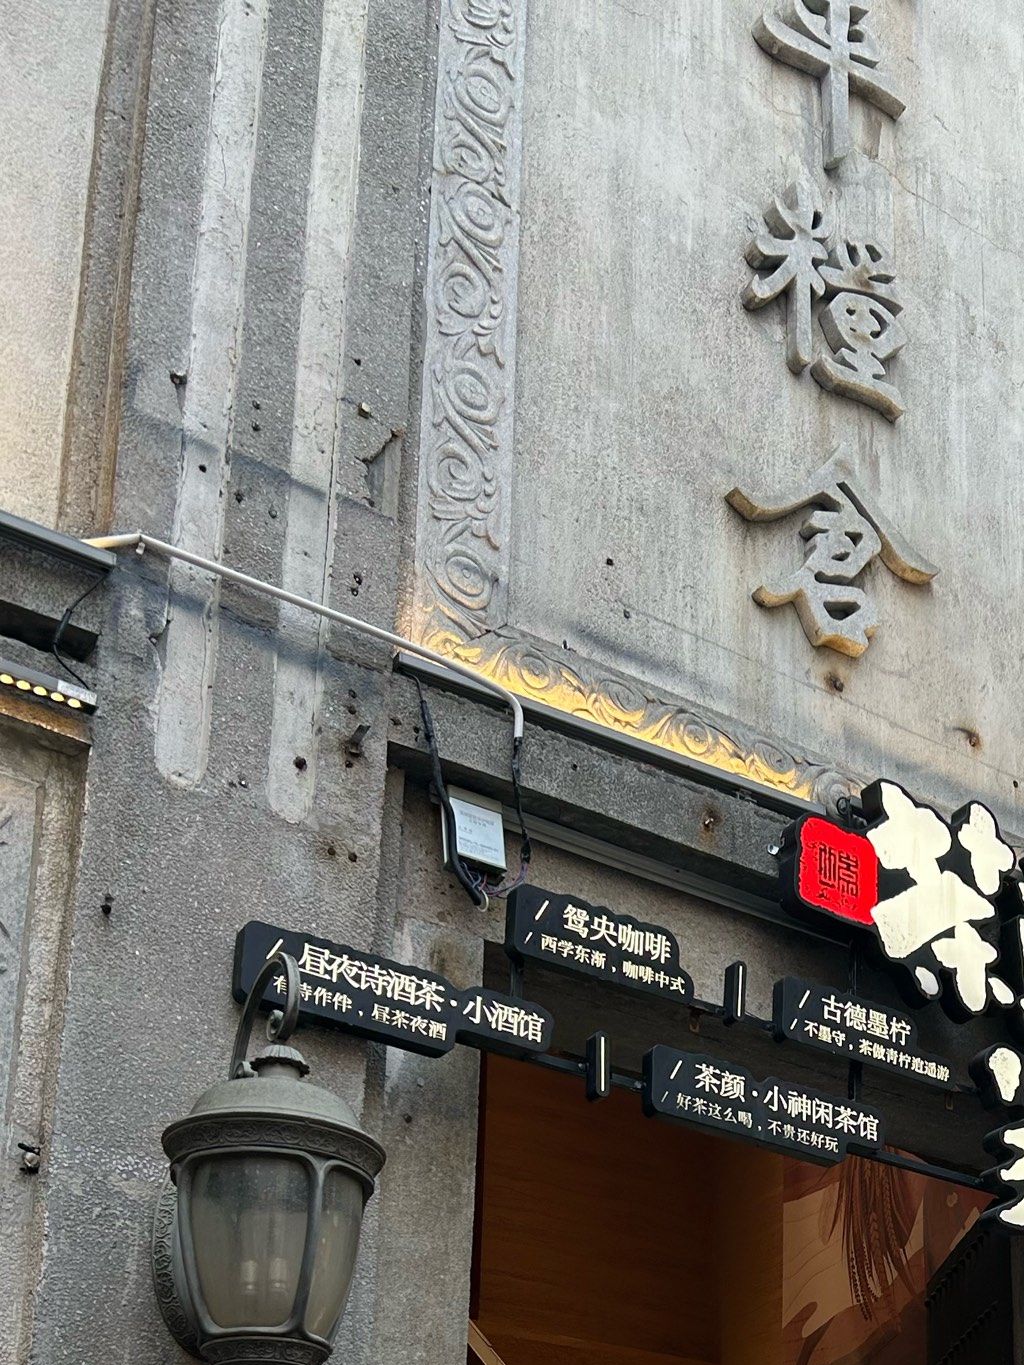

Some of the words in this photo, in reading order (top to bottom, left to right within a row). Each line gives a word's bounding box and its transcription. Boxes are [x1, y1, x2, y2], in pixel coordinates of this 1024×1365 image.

[540, 933, 687, 996] 西学东渐，咖啡中式
[563, 903, 672, 964] 鸳央咖啡
[298, 942, 546, 1044] 昼夜诗酒茶·小酒馆
[821, 995, 913, 1046] 古德墨柠
[675, 1092, 840, 1154] 好茶这么喝，不贵还好玩
[694, 1063, 881, 1142] 茶颜·小神闲茶馆
